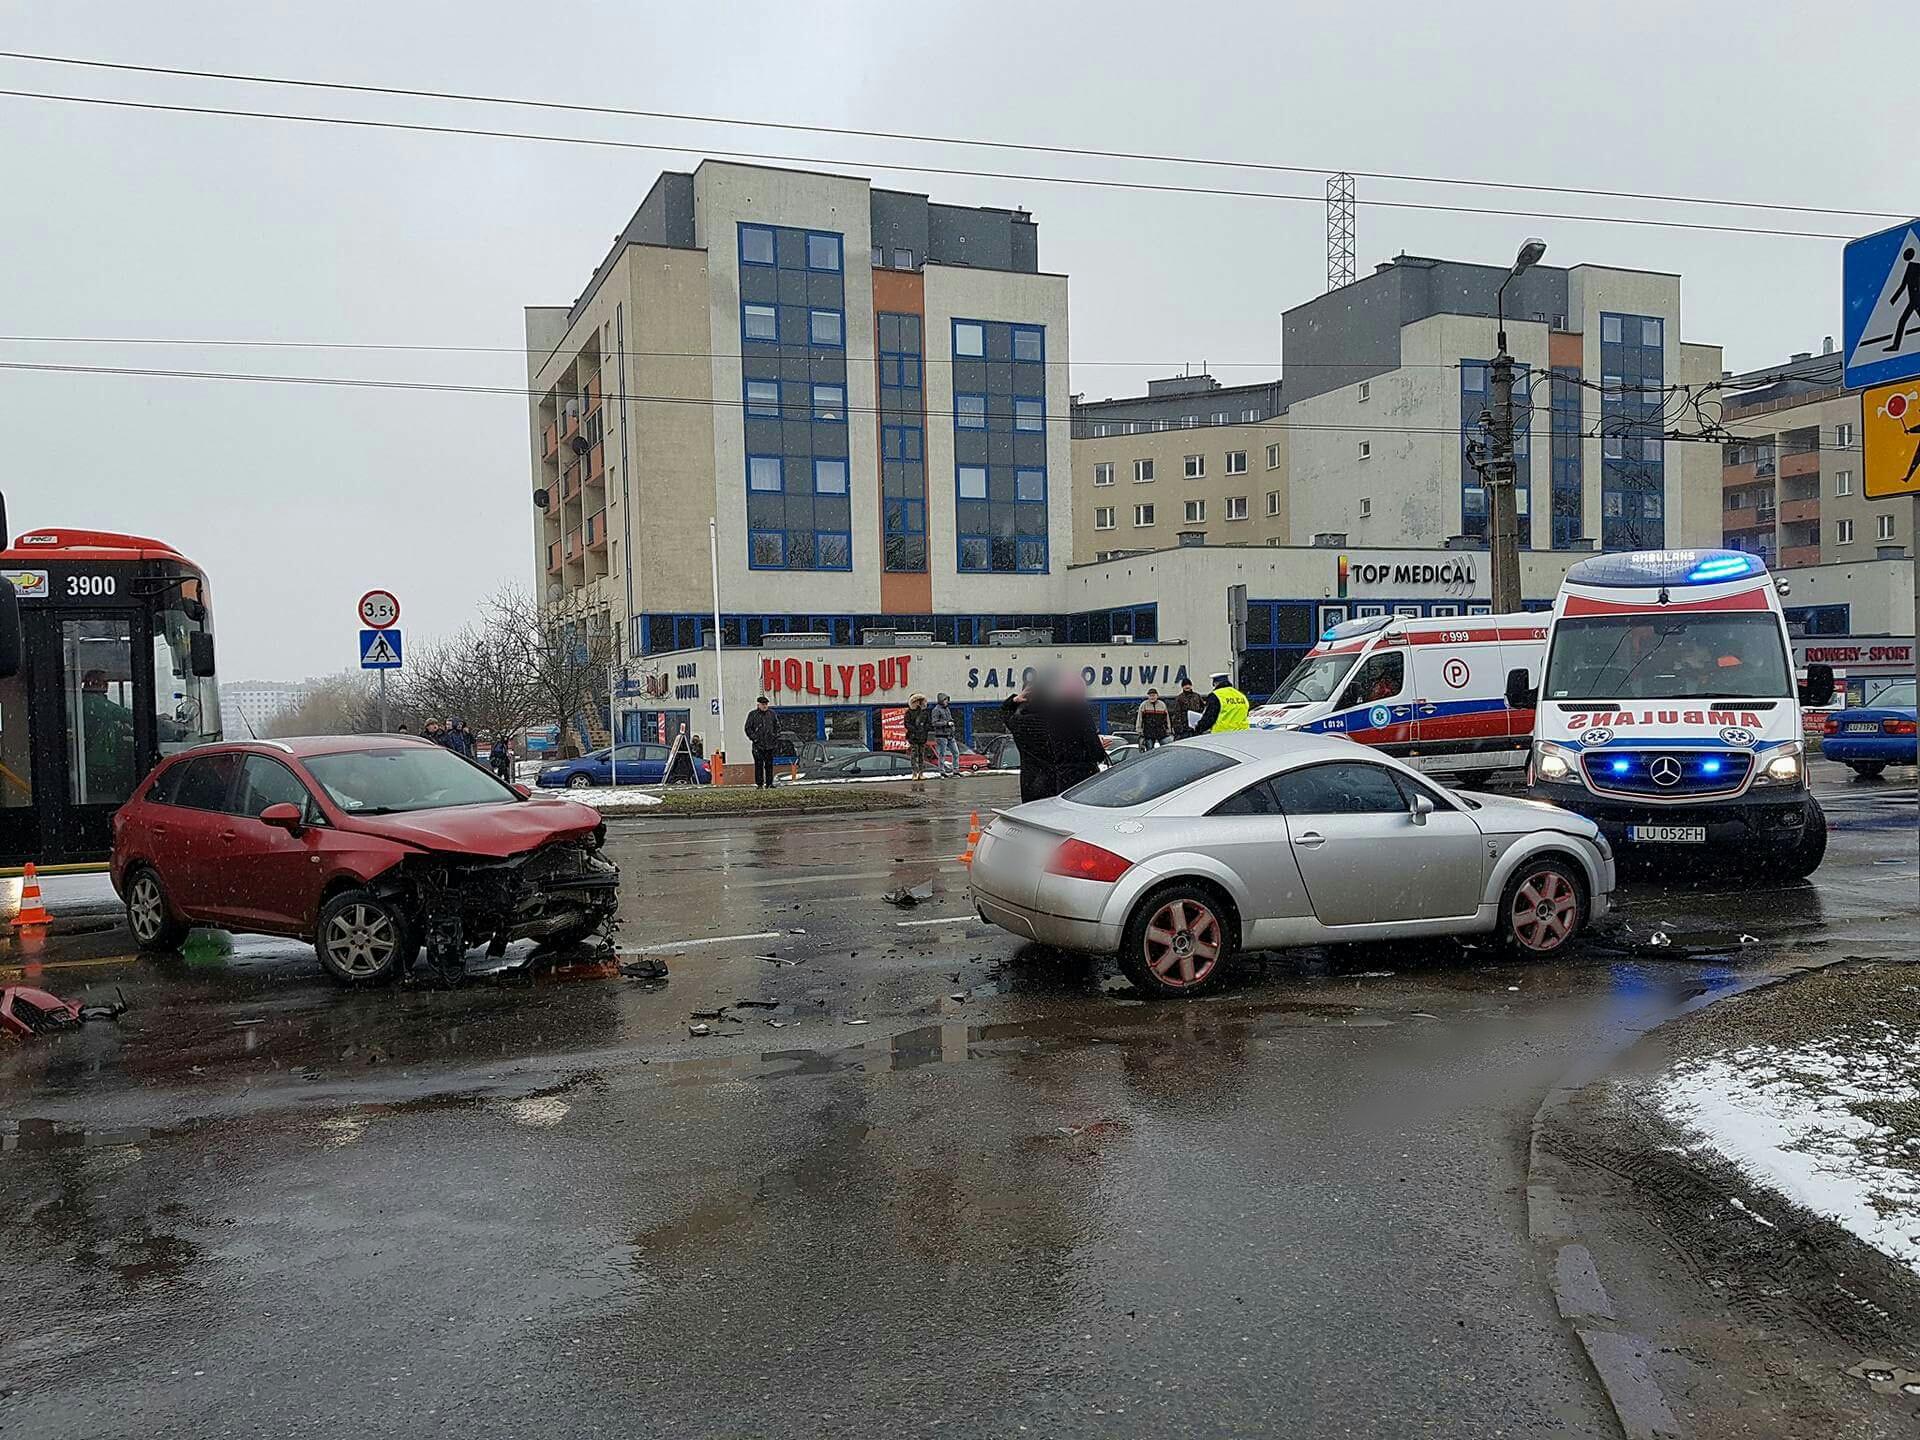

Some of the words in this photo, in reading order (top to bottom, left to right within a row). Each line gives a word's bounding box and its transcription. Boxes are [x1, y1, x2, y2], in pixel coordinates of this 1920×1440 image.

[1351, 564, 1391, 584] TOP
[1394, 564, 1477, 585] MEDICAL
[66, 575, 116, 596] 3900
[364, 602, 395, 618] 3,5t
[1449, 631, 1469, 642] 999
[762, 654, 912, 699] HOLLYBUT
[966, 666, 1039, 689] SALO
[1080, 665, 1190, 687] OBUWIA
[1636, 827, 1656, 840] LU
[1660, 827, 1705, 841] 052FH
